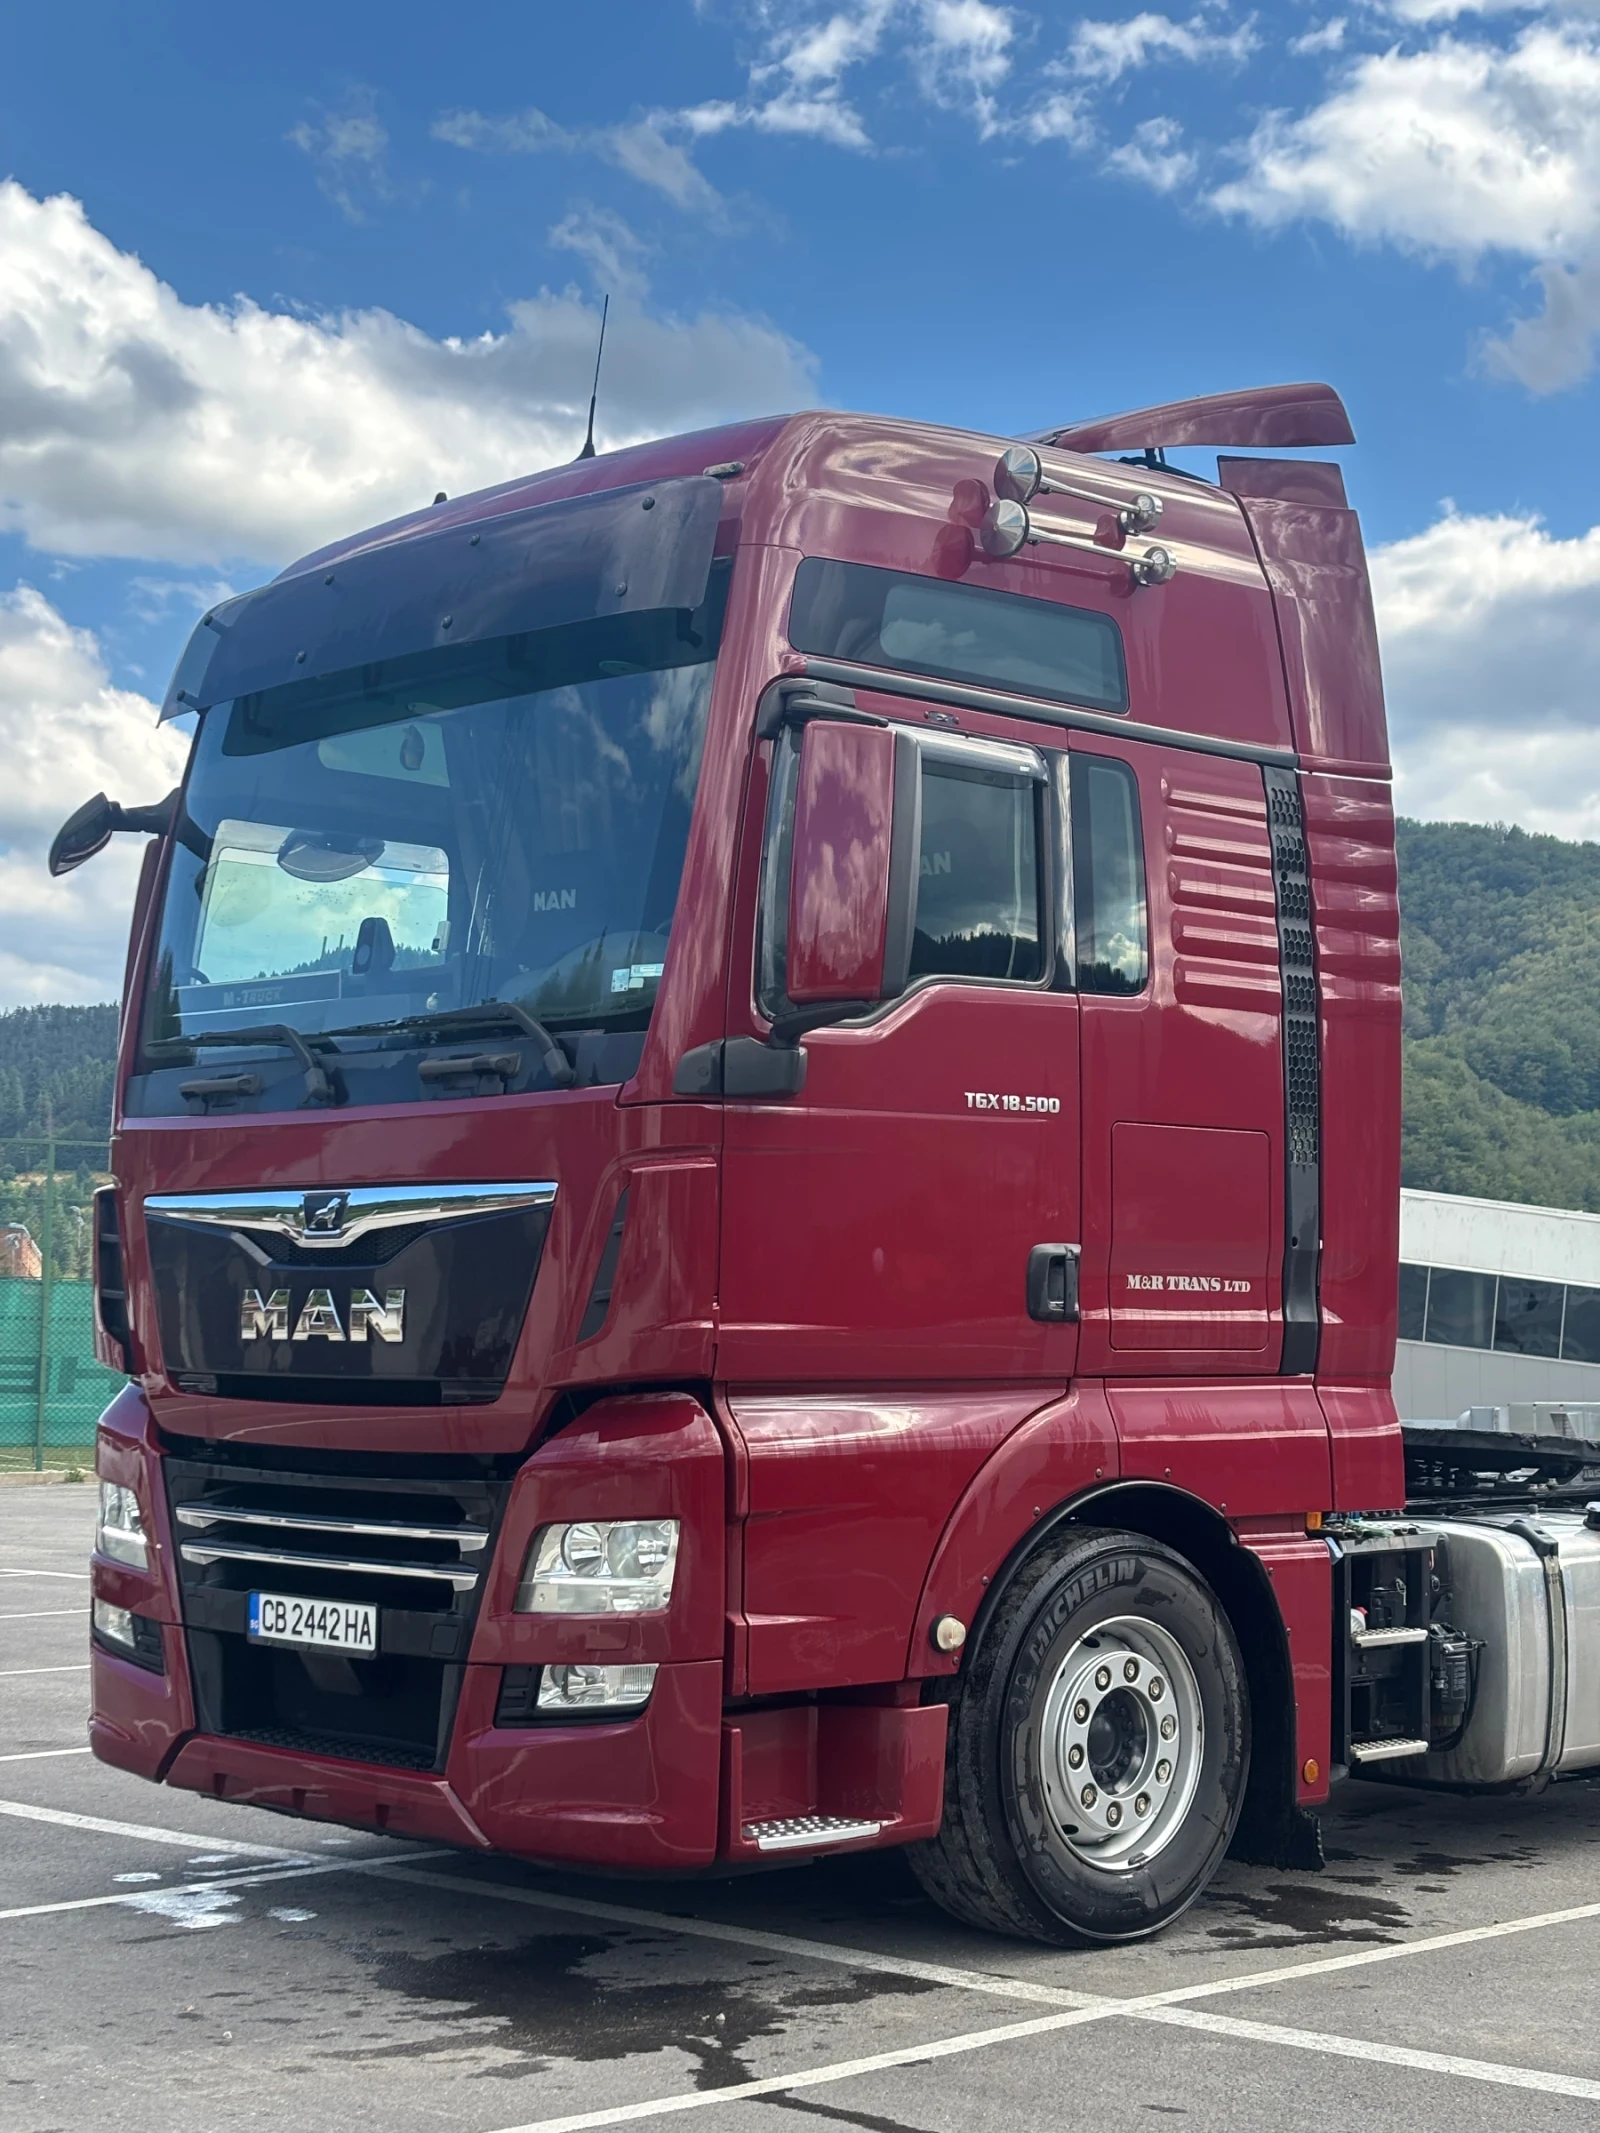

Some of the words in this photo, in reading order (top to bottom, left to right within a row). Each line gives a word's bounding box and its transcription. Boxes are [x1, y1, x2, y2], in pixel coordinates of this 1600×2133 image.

[920, 851, 951, 875] AN
[534, 889, 576, 912] MAN
[964, 1092, 999, 1110] TGX
[1001, 1095, 1060, 1113] 18.500
[1126, 1274, 1164, 1290] M&R
[1166, 1276, 1221, 1291] TRANS
[1223, 1280, 1251, 1292] LTD
[241, 1288, 405, 1342] MAN
[262, 1599, 287, 1633] CB
[291, 1603, 341, 1641] 2442
[345, 1608, 372, 1645] HA
[1029, 1559, 1136, 1666] MICHELIN
